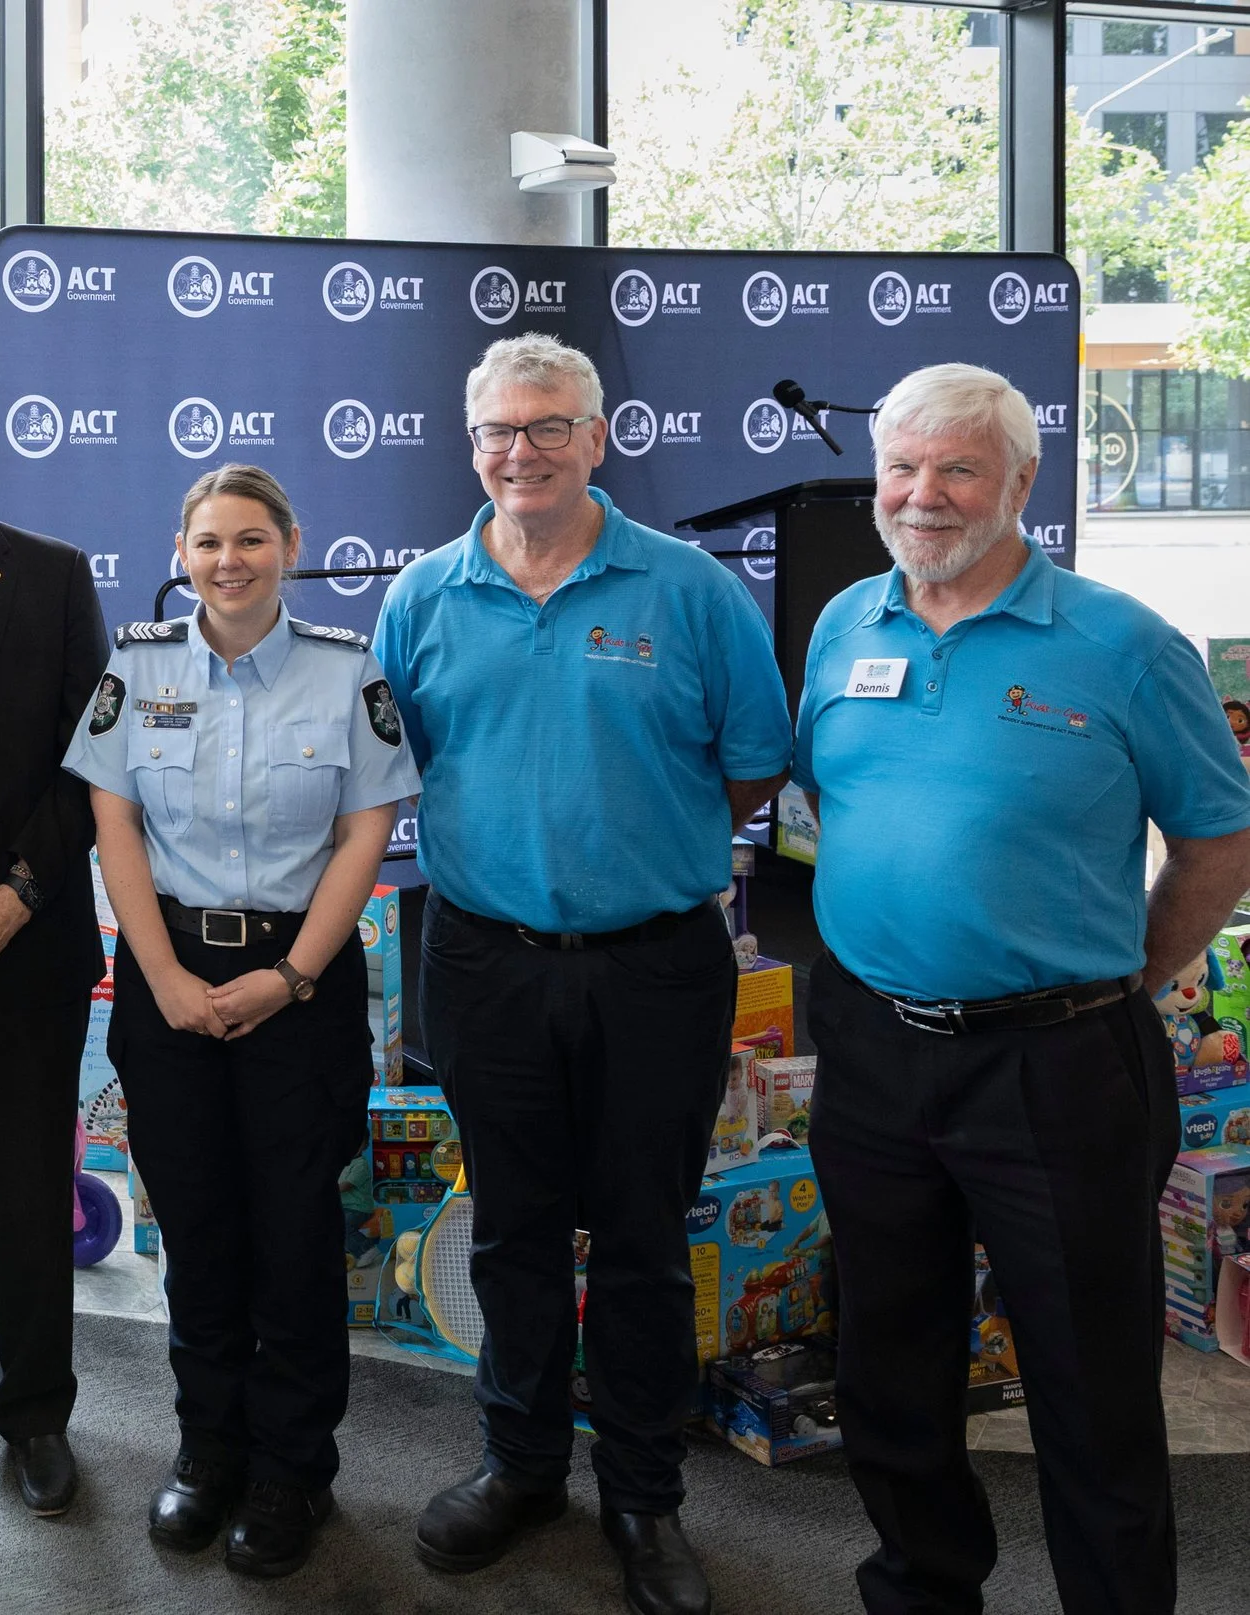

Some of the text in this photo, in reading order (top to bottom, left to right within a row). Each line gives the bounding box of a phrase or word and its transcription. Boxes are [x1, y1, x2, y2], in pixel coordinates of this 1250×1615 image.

[67, 267, 116, 290] ACT
[228, 272, 274, 295] ACT
[380, 277, 424, 300] ACT
[524, 280, 567, 303] ACT
[662, 284, 701, 305] ACT
[792, 284, 830, 305] ACT
[915, 283, 952, 304] ACT
[1034, 283, 1069, 304] ACT
[67, 292, 116, 302] Government
[228, 297, 274, 306] Government
[380, 301, 424, 311] Government
[524, 304, 567, 313] Government
[662, 306, 701, 314] Government
[792, 306, 830, 314] Government
[915, 305, 952, 313] Government
[1034, 305, 1069, 313] Government
[1034, 404, 1067, 425] ACT
[70, 410, 117, 434] ACT
[228, 412, 275, 435] ACT
[381, 413, 425, 436] ACT
[662, 412, 701, 434] ACT
[70, 436, 117, 445] Government
[228, 437, 275, 446] Government
[381, 437, 425, 446] Government
[662, 435, 701, 443] Government
[1033, 525, 1066, 546] ACT
[89, 554, 120, 578] CT
[94, 580, 120, 588] nment
[855, 682, 890, 693] Dennis
[756, 1047, 776, 1059] STICO
[792, 1073, 815, 1088] MARV
[1185, 1121, 1215, 1134] vtech
[87, 1137, 109, 1145] Teaches
[799, 1182, 807, 1193] 4
[1002, 1389, 1025, 1401] HAUL
